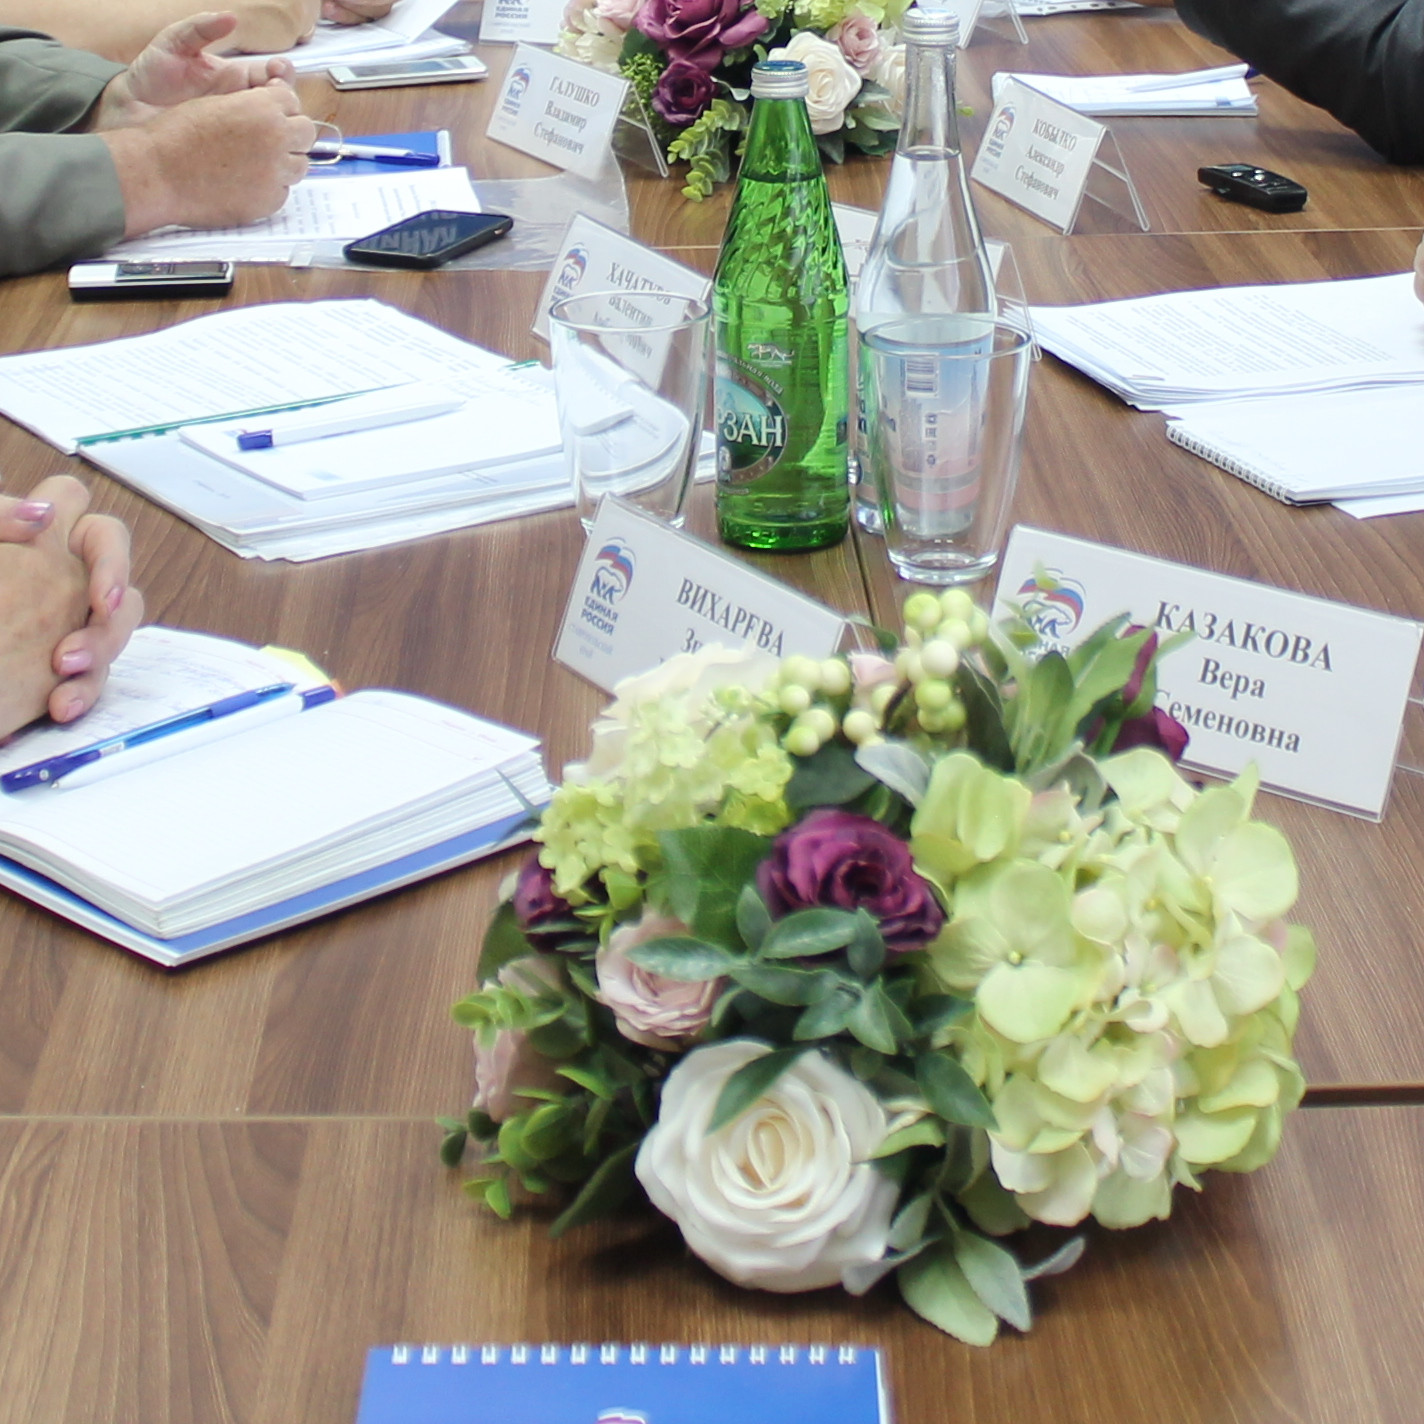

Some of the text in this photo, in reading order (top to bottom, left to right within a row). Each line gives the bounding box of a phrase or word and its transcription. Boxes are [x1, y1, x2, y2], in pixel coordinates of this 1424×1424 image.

[580, 608, 615, 636] РОССИЯ
[676, 576, 785, 658] ВИХАРЕВА
[1154, 599, 1334, 673] КАЗАКОВА
[1197, 656, 1268, 701] Вера
